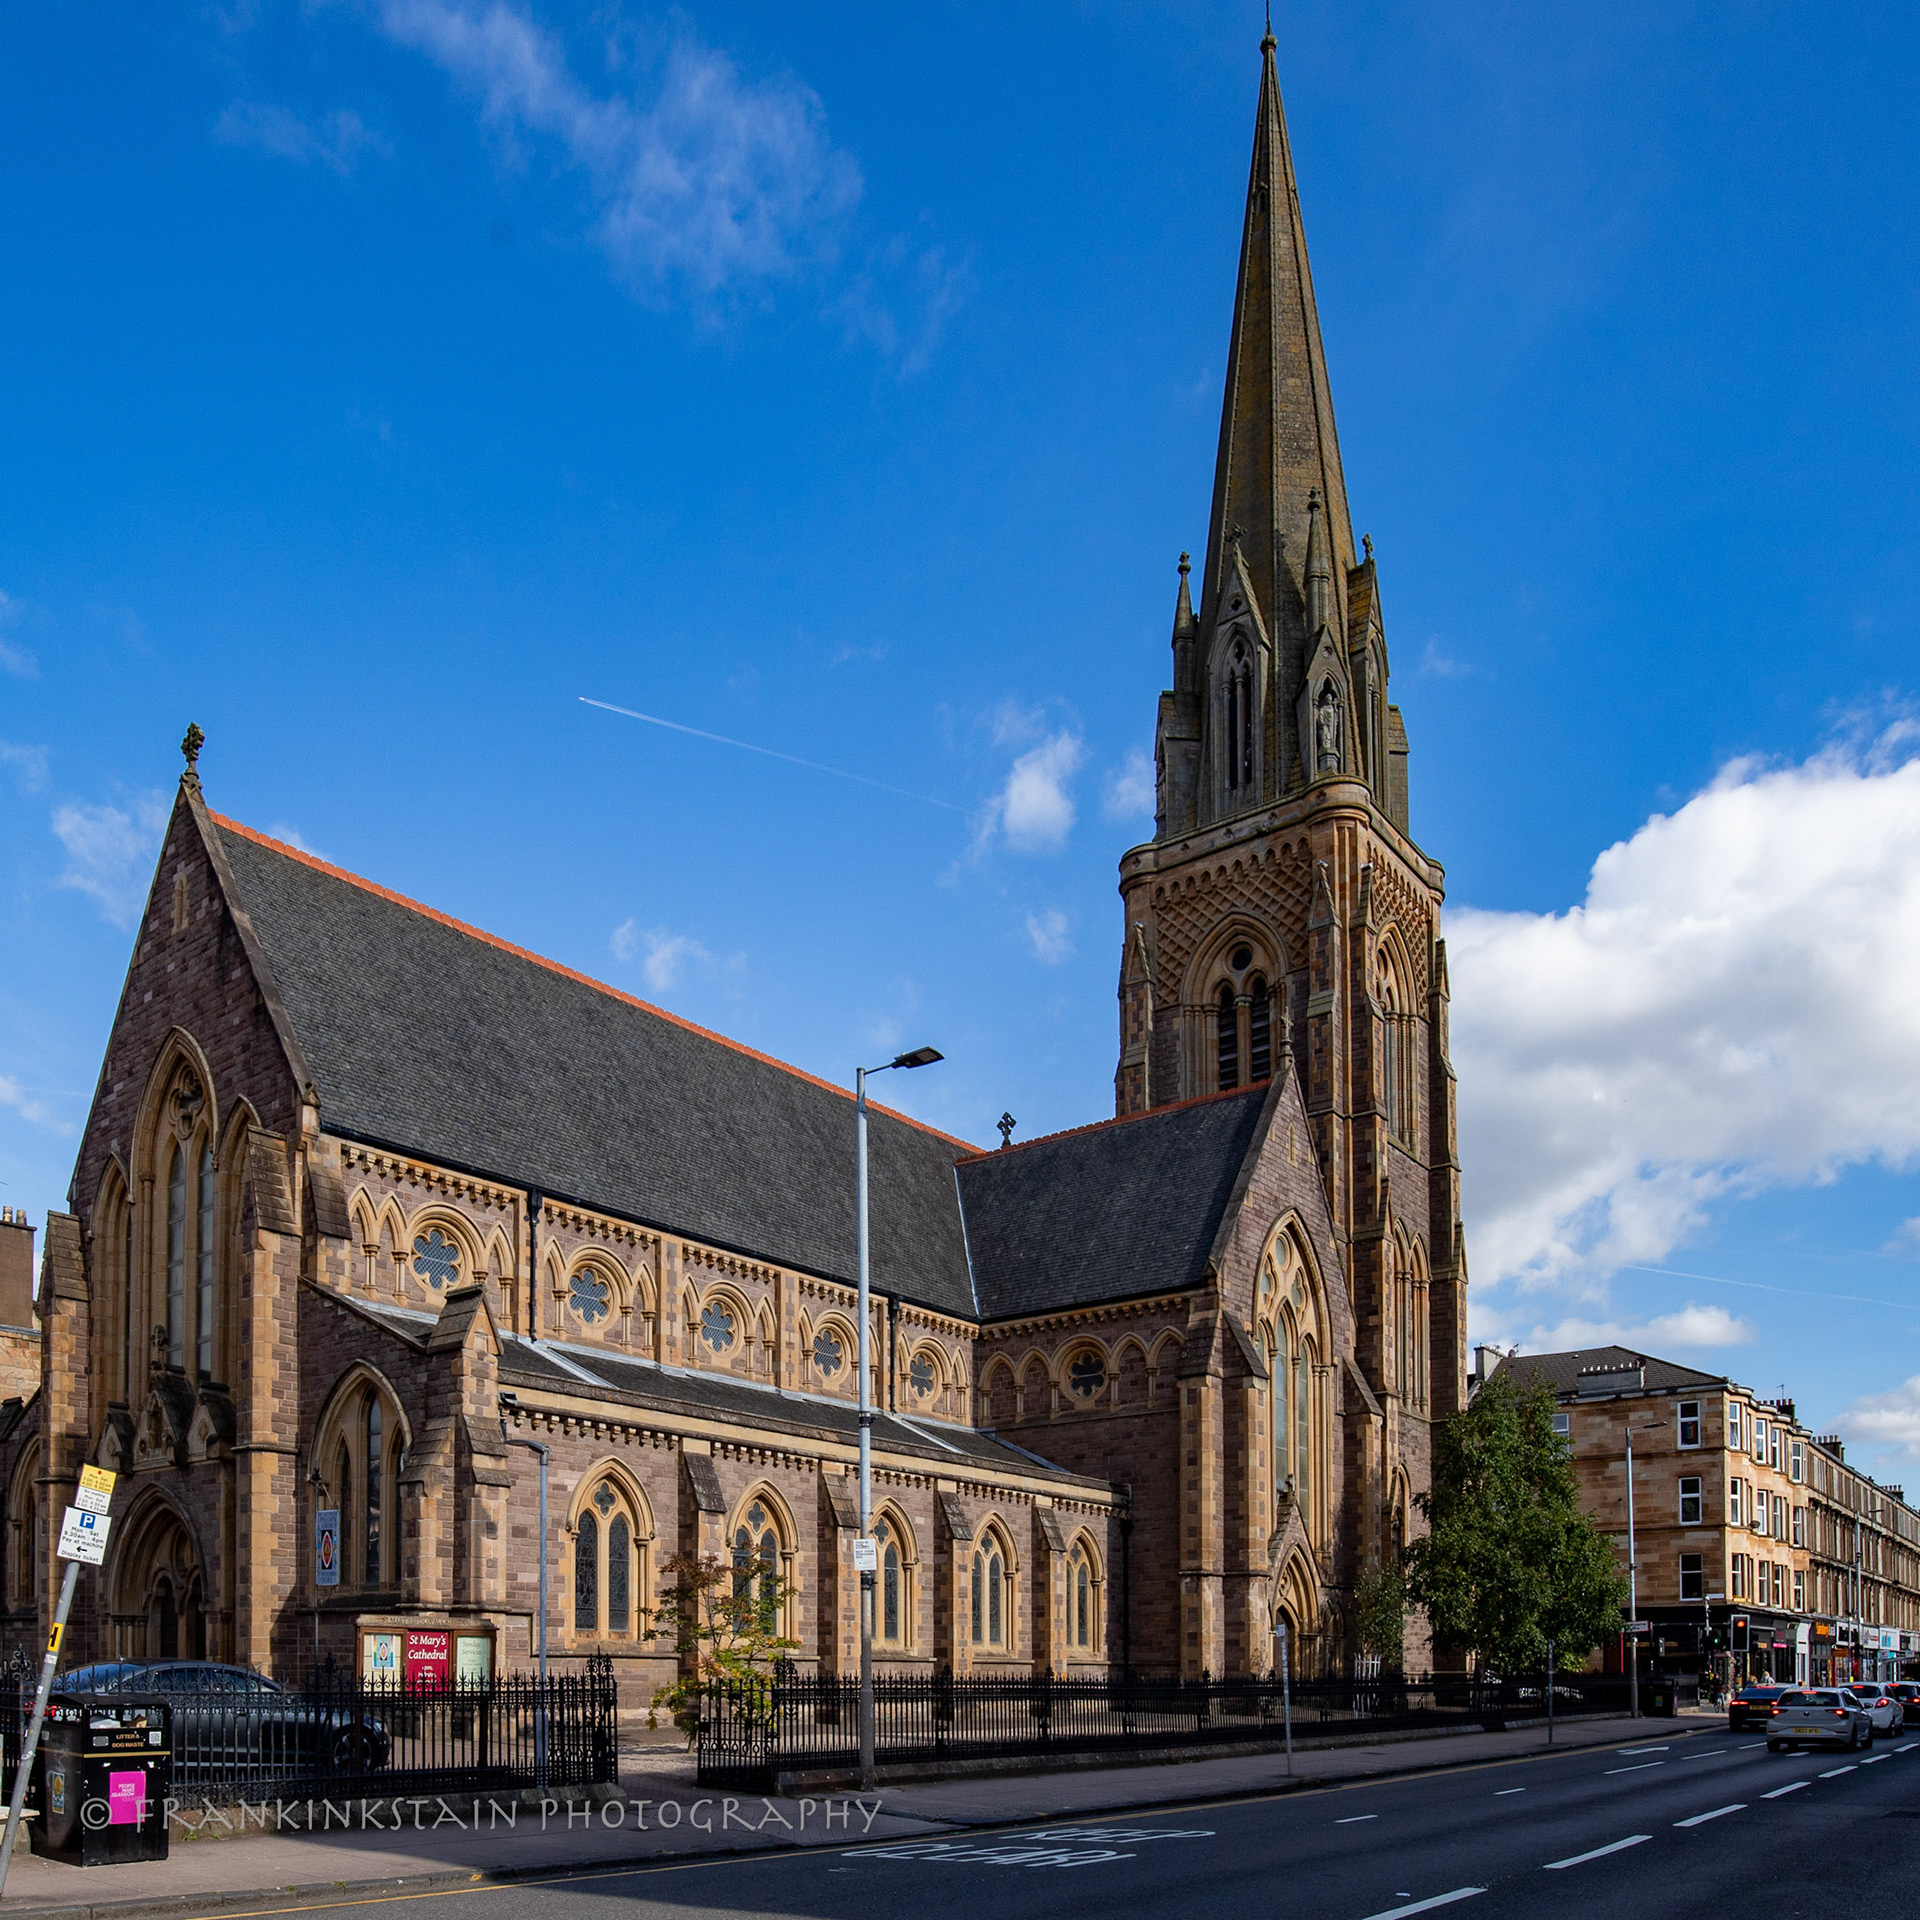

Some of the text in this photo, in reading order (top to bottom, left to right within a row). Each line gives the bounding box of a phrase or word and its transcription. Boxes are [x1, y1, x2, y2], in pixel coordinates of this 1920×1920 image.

[83, 1515, 93, 1526] P
[82, 1540, 103, 1549] machine
[61, 1550, 99, 1562] Display ticket
[409, 1635, 446, 1648] St Mary's
[408, 1649, 447, 1660] Cathedral
[997, 1828, 1216, 1843] KEEP
[841, 1844, 1137, 1868] CLEAR
